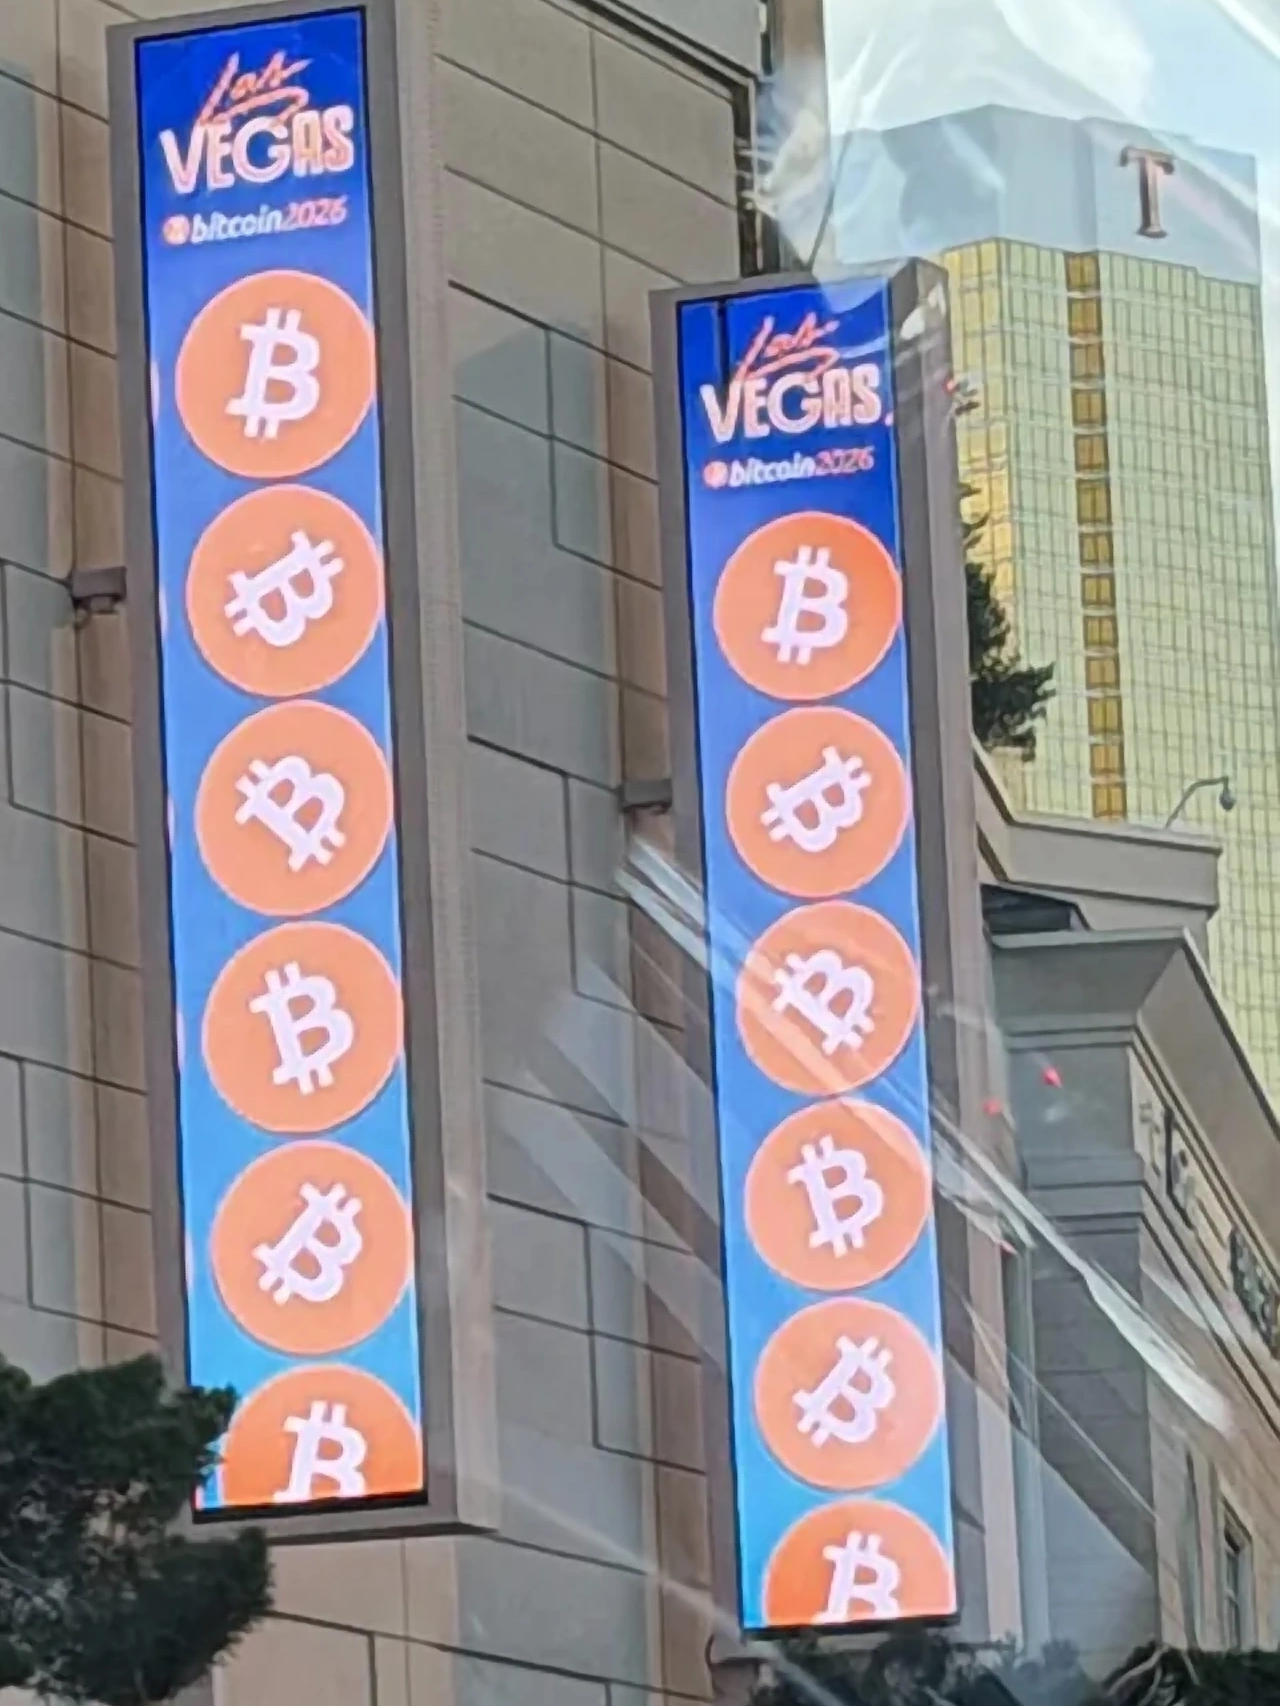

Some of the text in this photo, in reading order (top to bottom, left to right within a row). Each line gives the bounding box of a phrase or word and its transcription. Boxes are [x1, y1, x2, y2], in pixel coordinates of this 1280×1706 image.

[198, 50, 314, 125] Las
[159, 105, 354, 194] VEGAS
[1118, 146, 1174, 239] T
[735, 312, 840, 381] Las
[699, 363, 881, 443] VEGAS
